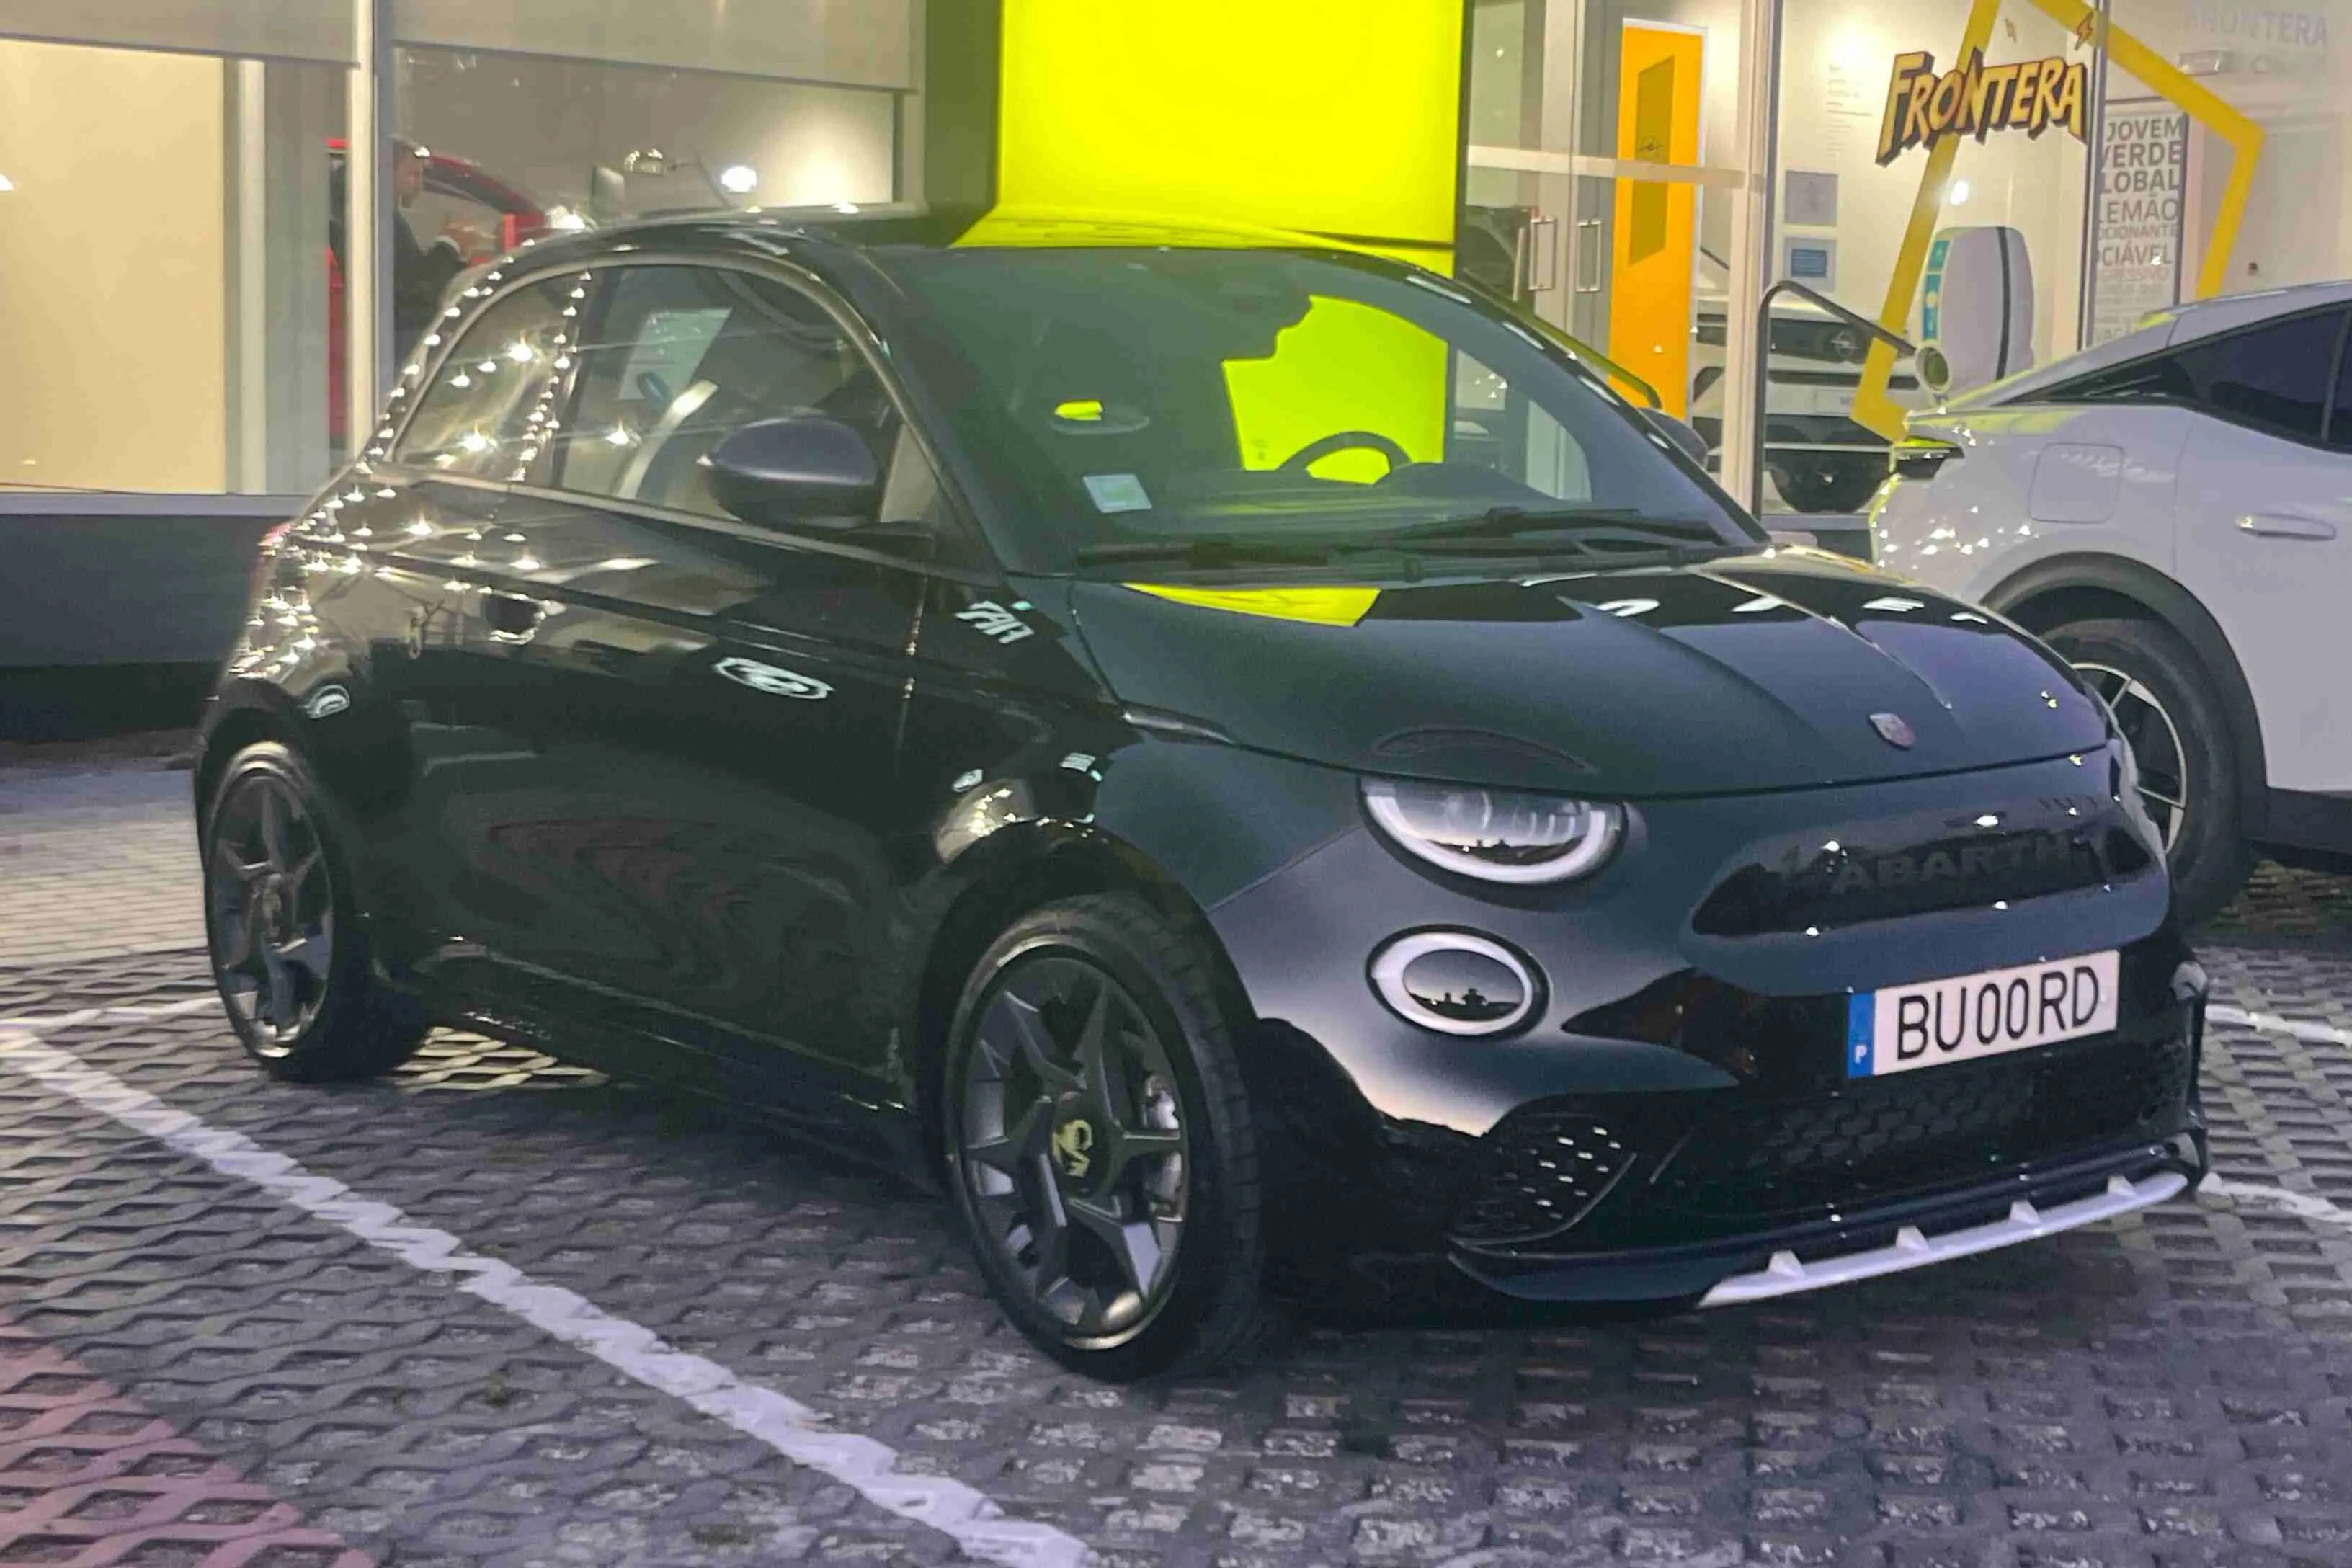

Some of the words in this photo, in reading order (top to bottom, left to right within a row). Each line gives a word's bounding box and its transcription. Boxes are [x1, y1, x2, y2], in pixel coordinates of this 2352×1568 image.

[1875, 47, 2088, 167] FRONTERA
[2106, 117, 2182, 141] JOVEM
[1854, 1044, 1868, 1065] P
